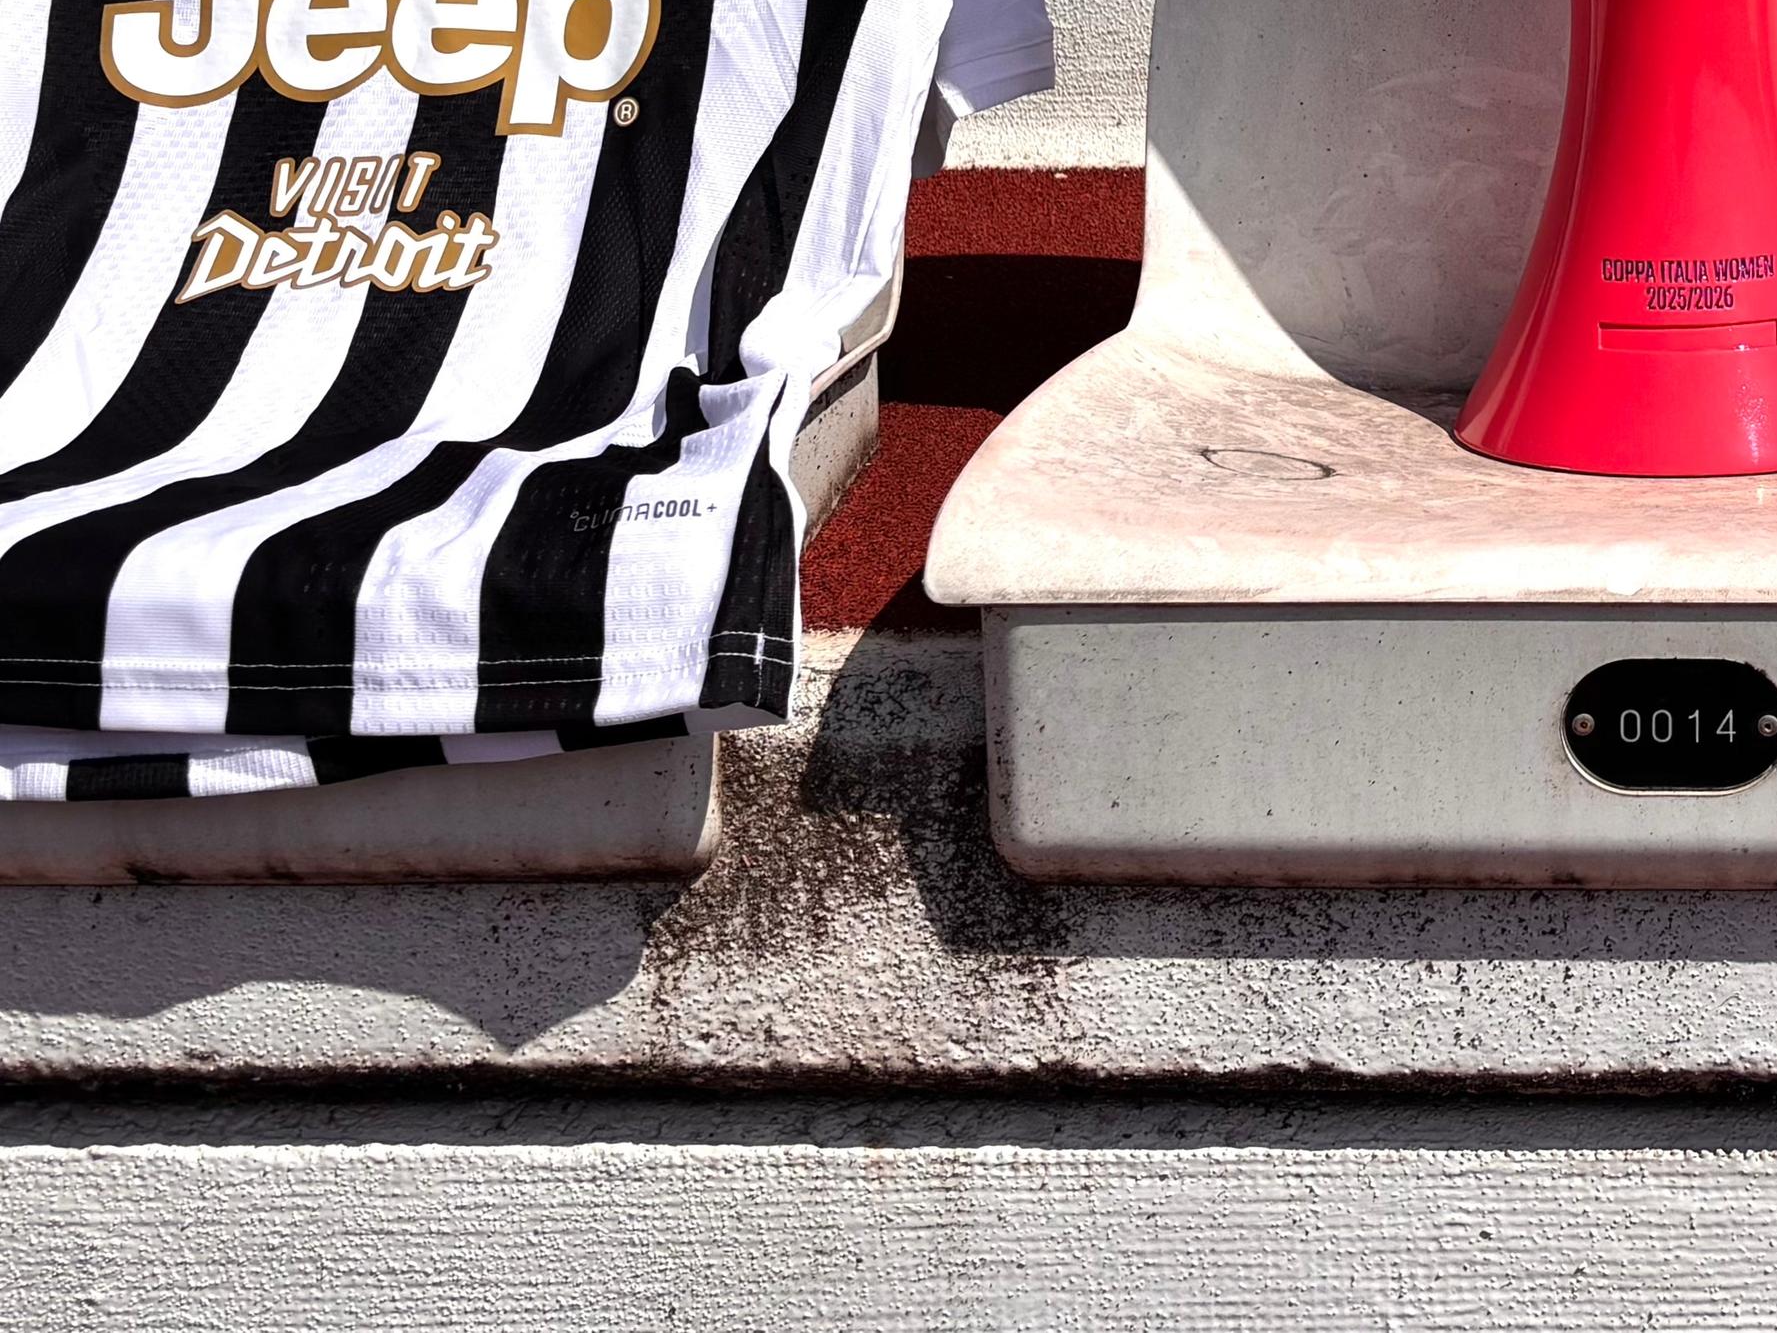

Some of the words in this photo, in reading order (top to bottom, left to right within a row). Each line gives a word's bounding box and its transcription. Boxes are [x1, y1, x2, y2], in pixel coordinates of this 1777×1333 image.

[270, 151, 442, 218] VISIT
[173, 209, 500, 305] Detroit
[1602, 257, 1656, 283] COPPA
[1660, 259, 1710, 284] ITALIA
[1713, 254, 1775, 283] WOMEN
[1646, 285, 1735, 311] 2025/2026
[1619, 708, 1737, 744] 0014
